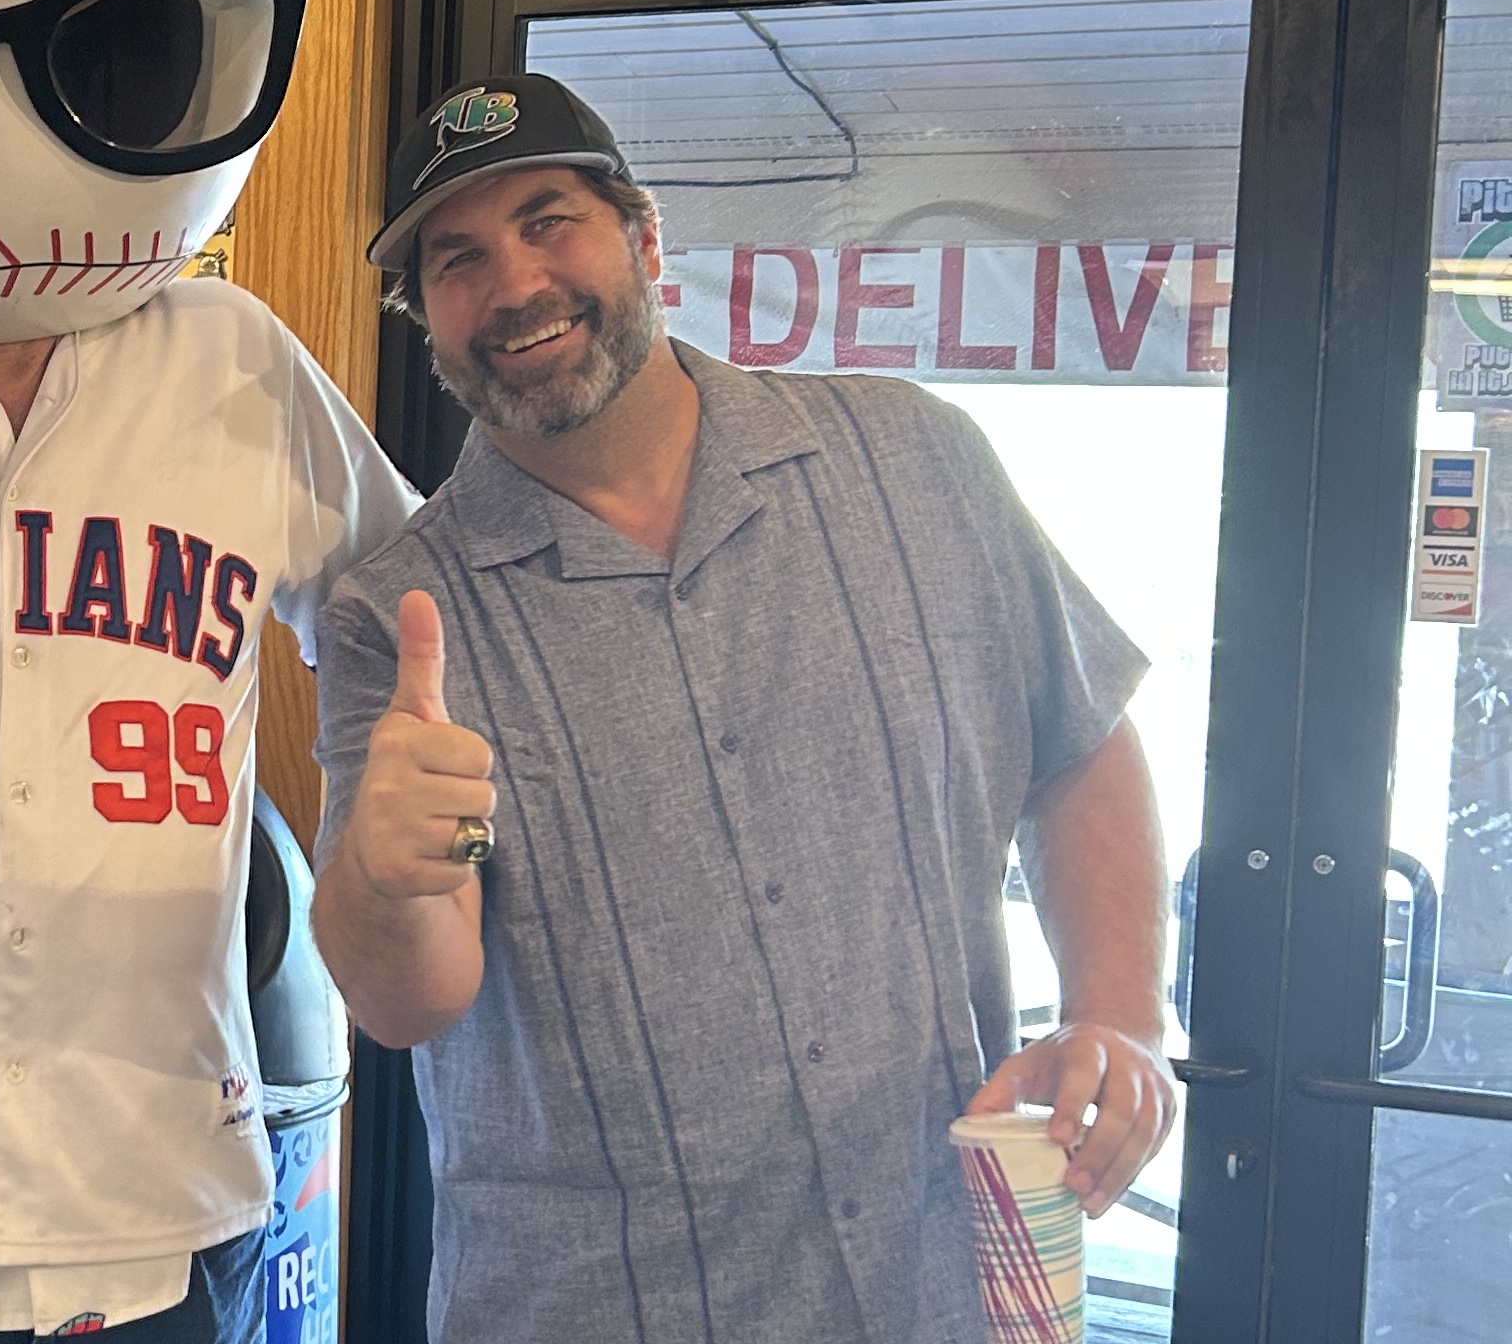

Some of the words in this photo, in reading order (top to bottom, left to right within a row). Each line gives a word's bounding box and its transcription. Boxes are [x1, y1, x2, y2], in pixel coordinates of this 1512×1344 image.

[428, 86, 520, 133] TB
[1428, 553, 1468, 567] VISA
[1421, 591, 1469, 602] DISCOVER
[88, 700, 229, 826] 99
